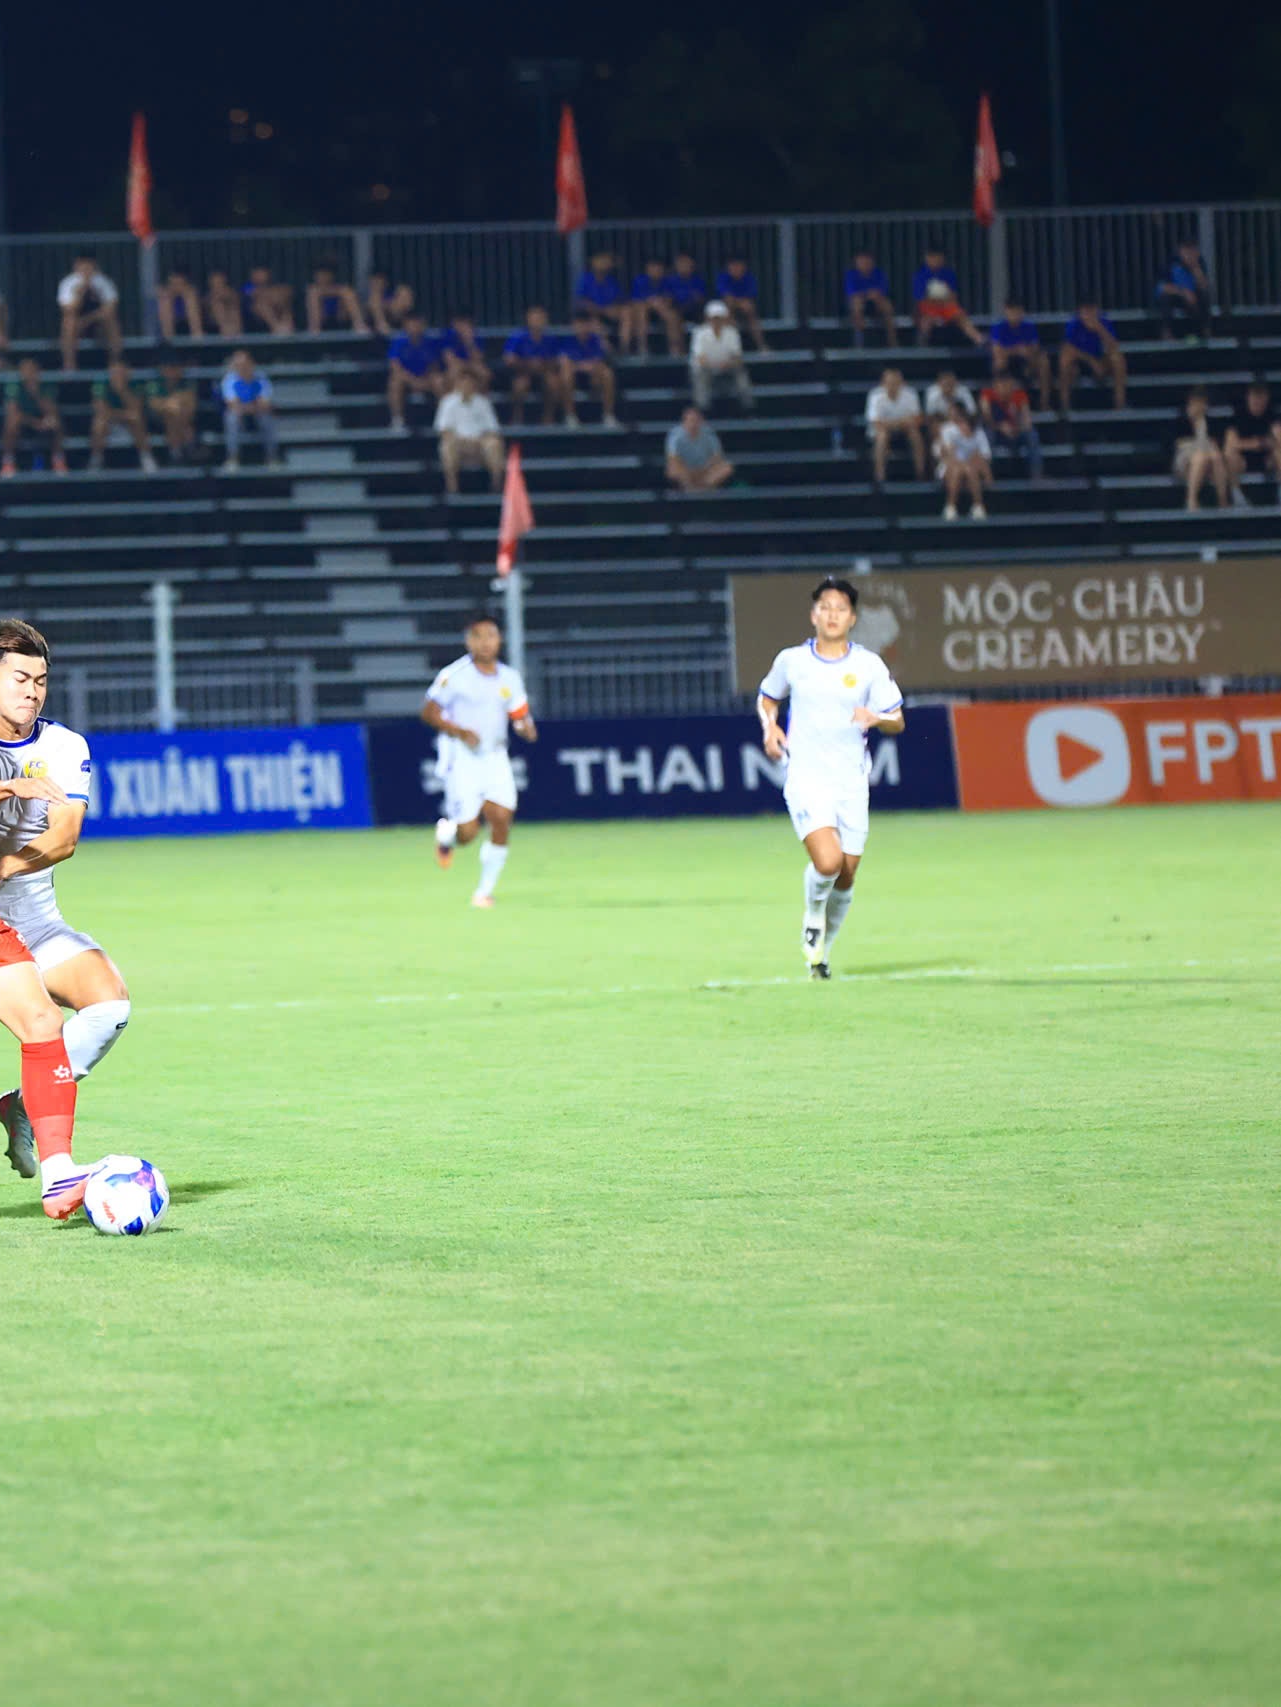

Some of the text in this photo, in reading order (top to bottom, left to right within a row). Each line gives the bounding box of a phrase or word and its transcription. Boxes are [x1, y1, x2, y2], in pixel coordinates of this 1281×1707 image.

[1072, 570, 1206, 622] CHÂU
[942, 623, 1205, 672] CREAMERY
[557, 743, 724, 796] THAI
[1145, 718, 1281, 787] FPT
[106, 746, 221, 819] XUÂN
[223, 740, 345, 823] THIỆN
